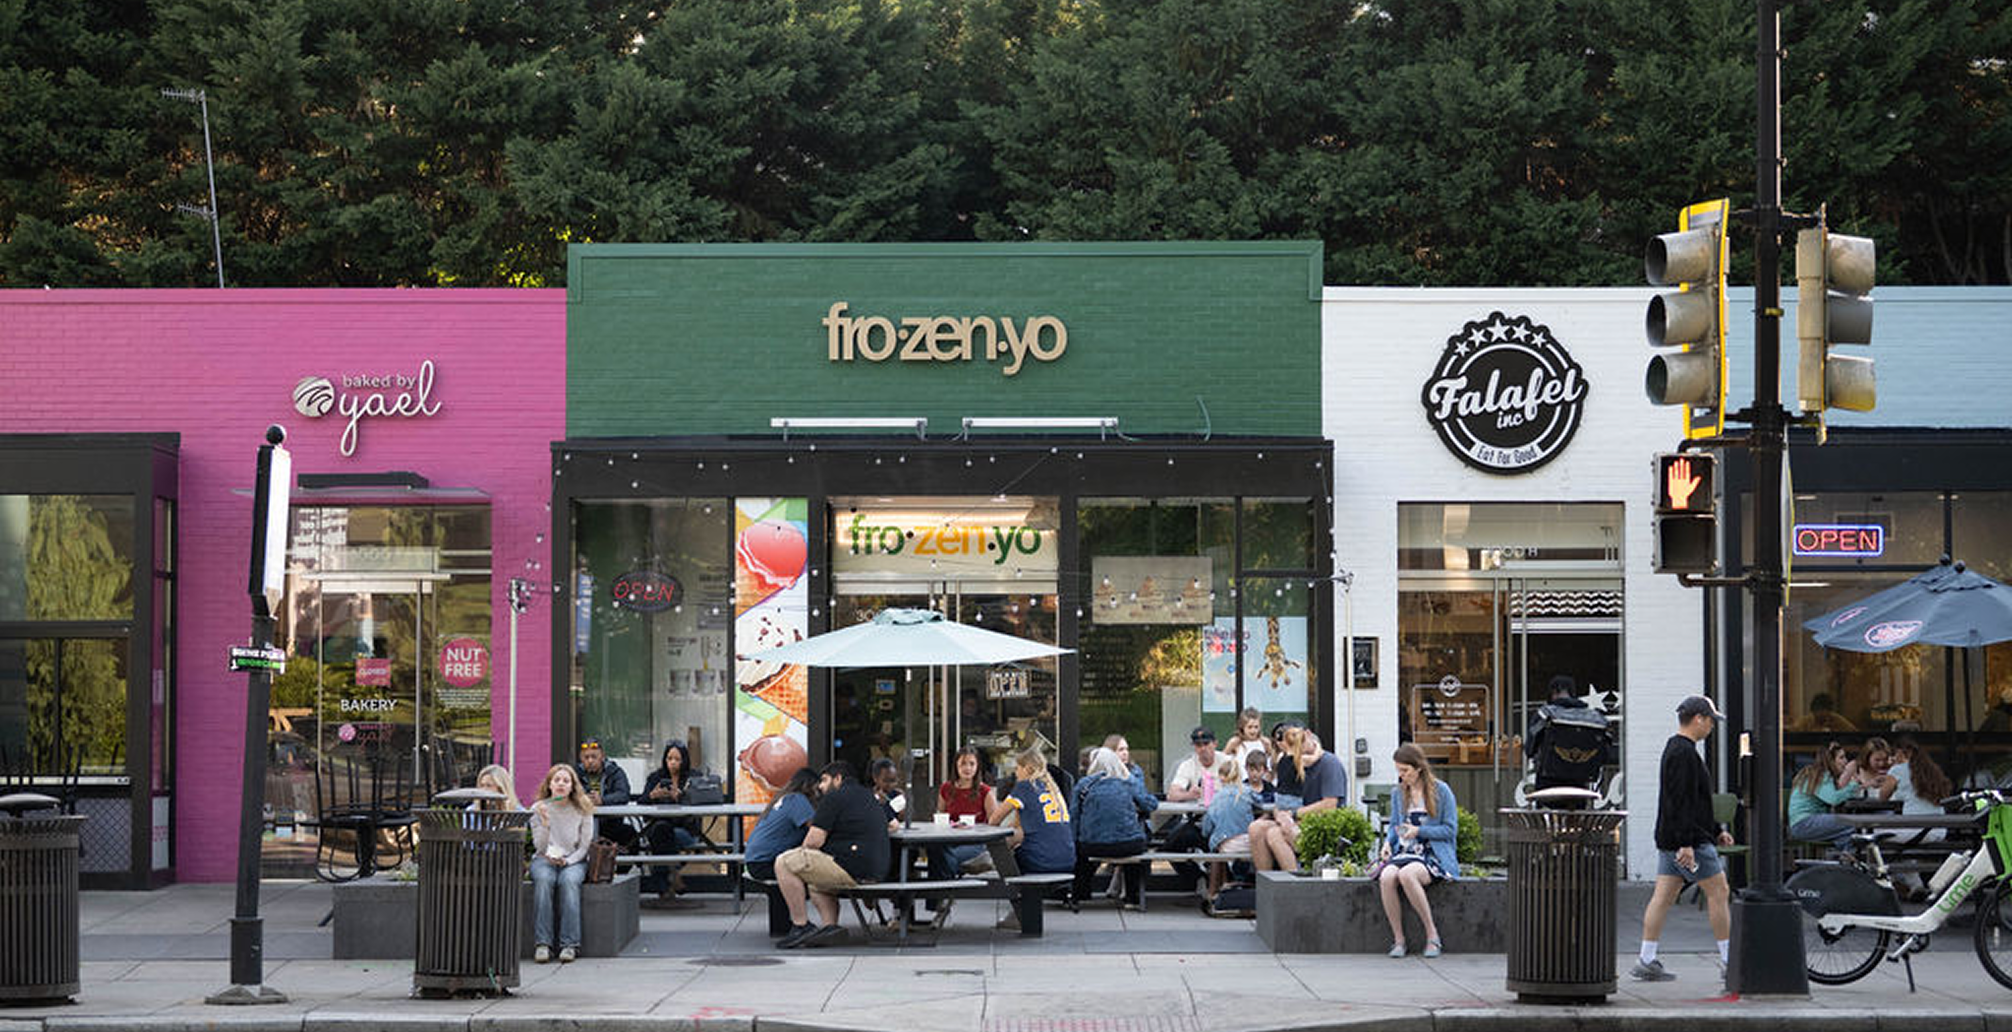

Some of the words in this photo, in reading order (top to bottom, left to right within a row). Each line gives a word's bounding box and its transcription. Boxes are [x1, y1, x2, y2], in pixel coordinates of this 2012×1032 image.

[342, 374, 391, 388] baked
[396, 374, 416, 390] by
[1429, 367, 1583, 420] Falafel
[338, 360, 442, 457] yael
[1496, 411, 1524, 429] inc
[1476, 447, 1495, 463] Eat
[1497, 450, 1511, 465] For
[1514, 446, 1538, 465] Good
[1797, 529, 1878, 551] OPEN
[613, 581, 675, 602] OPEN
[447, 648, 482, 661] NUT
[445, 663, 483, 677] FREE
[341, 699, 397, 712] BAKERY
